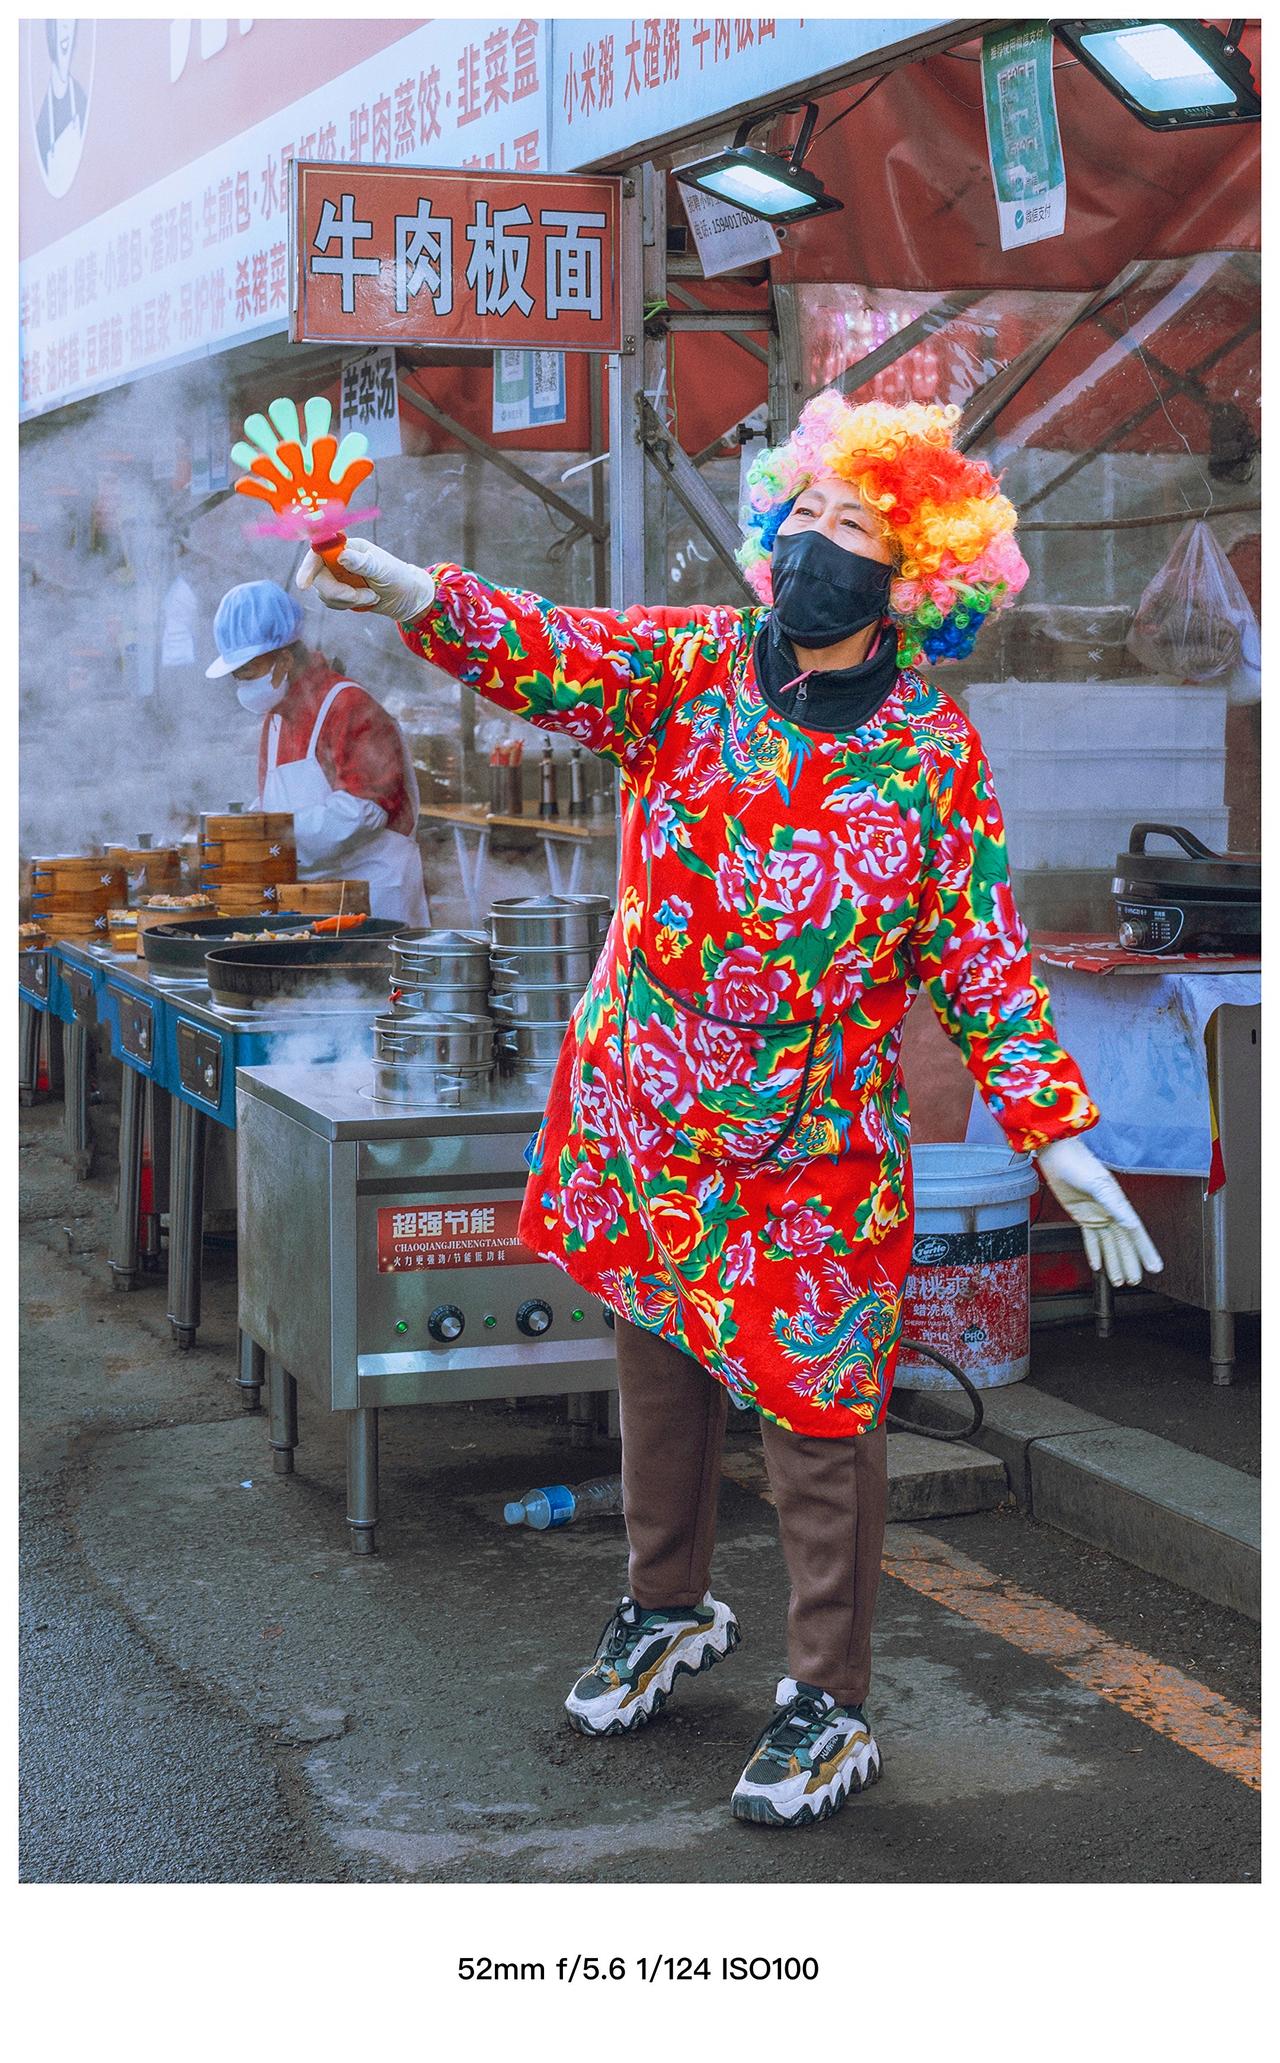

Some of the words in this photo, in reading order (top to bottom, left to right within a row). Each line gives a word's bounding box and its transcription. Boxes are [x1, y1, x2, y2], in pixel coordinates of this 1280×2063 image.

[563, 34, 614, 125] 小米粥
[1026, 203, 1051, 224] 微信支付
[236, 240, 288, 322] 杀猪菜
[311, 193, 607, 320] 牛肉板面
[342, 356, 395, 429] 羊杂汤
[392, 1207, 496, 1238] 超强节能
[394, 1237, 523, 1253] CHAOQIANGJIENENGTANGMI
[964, 1331, 985, 1340] PRO
